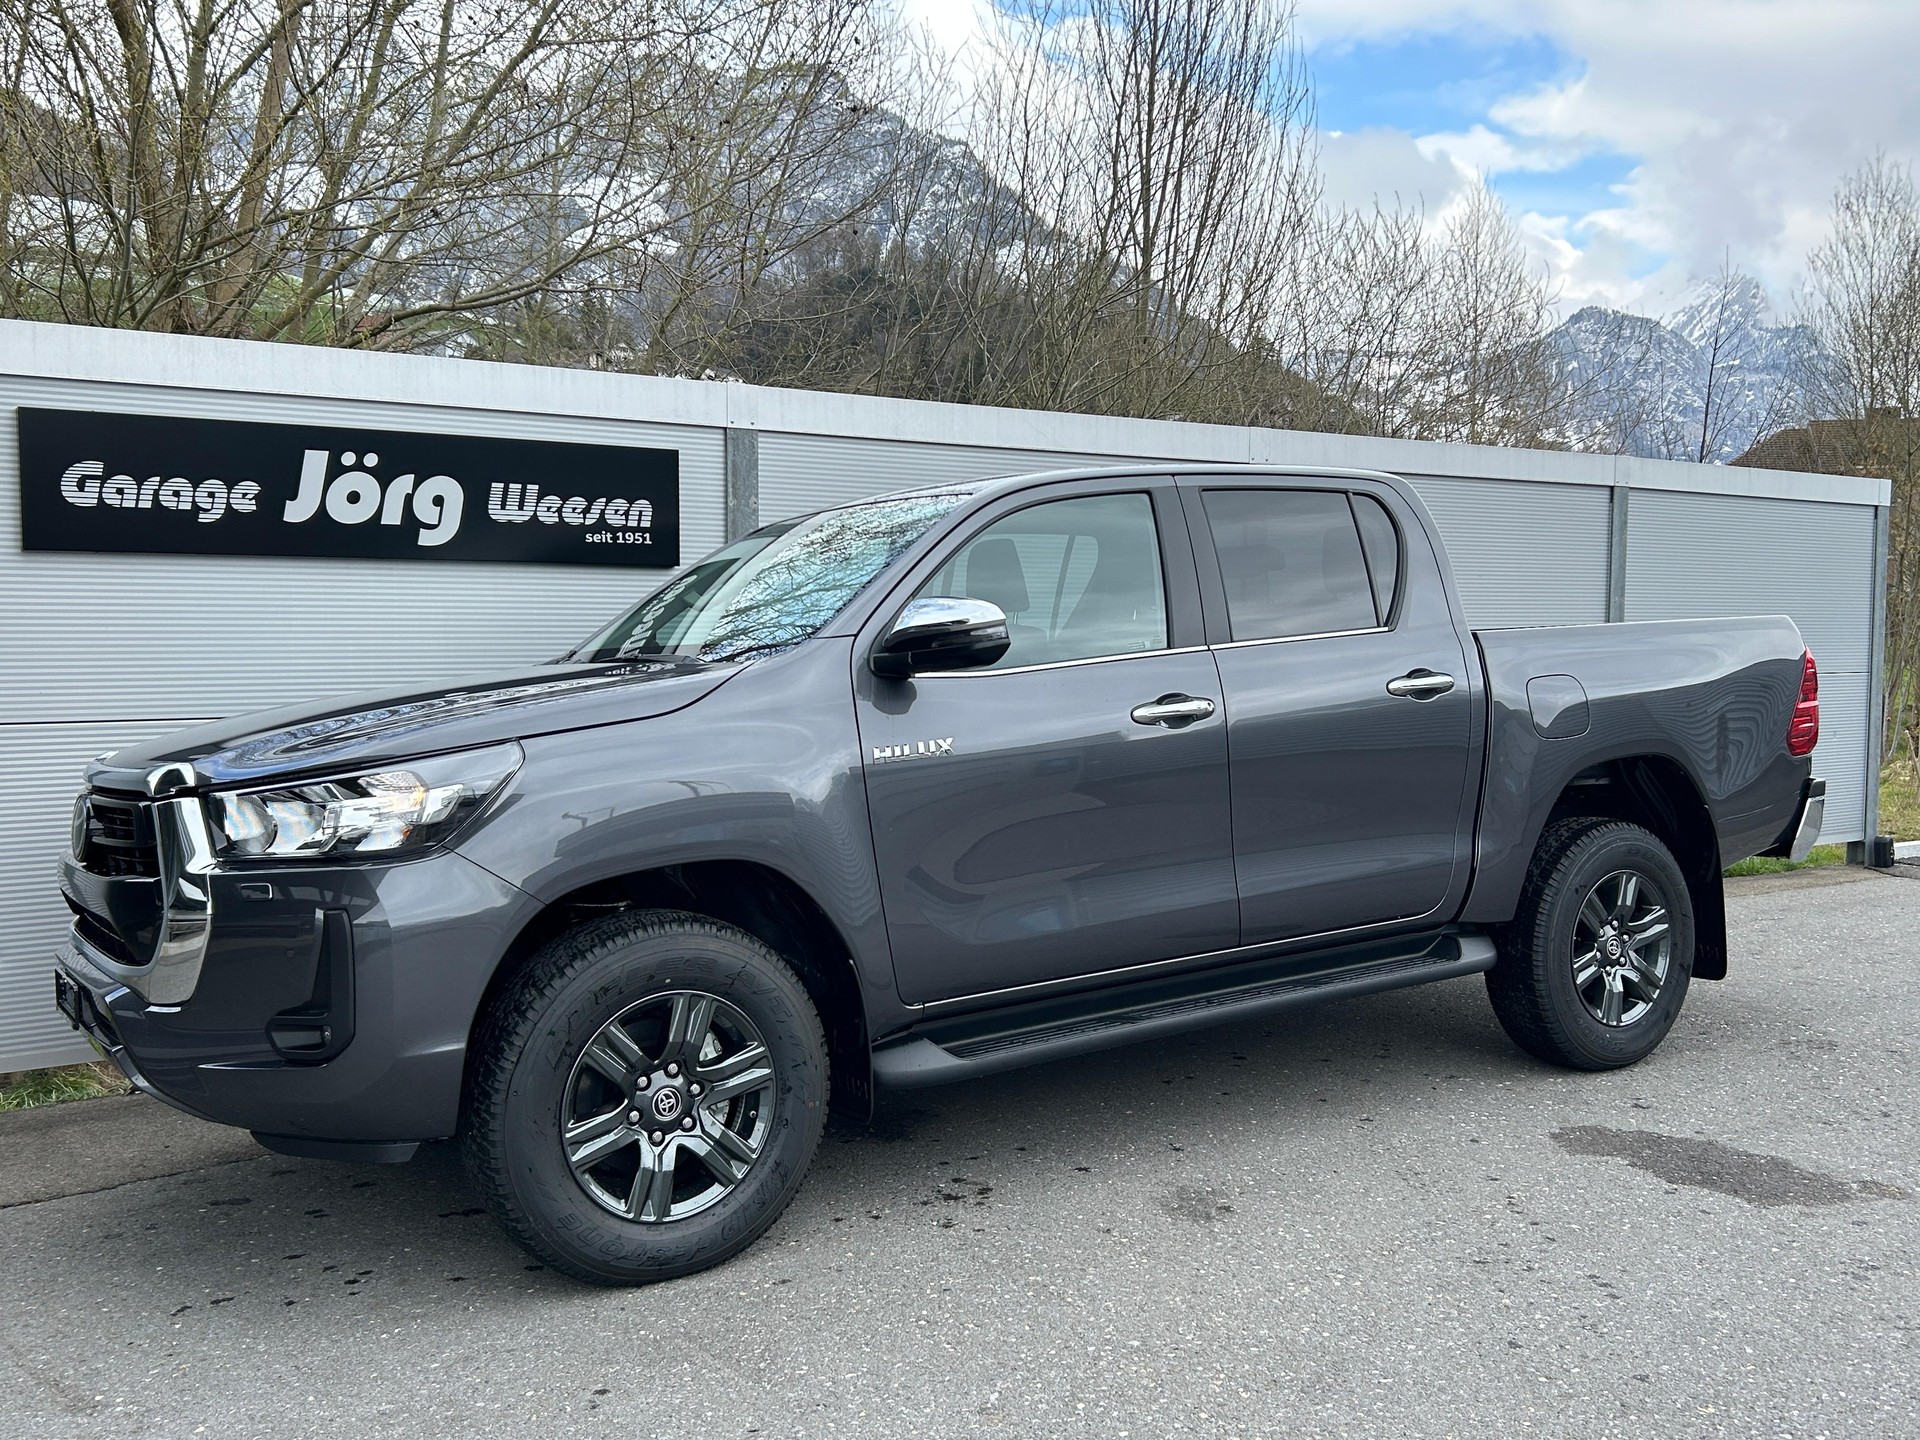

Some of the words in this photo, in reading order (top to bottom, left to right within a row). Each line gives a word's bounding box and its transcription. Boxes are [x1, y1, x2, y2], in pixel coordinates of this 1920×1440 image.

[60, 460, 262, 523] Garage
[283, 449, 465, 547] Jörg
[488, 482, 653, 528] Weesen
[585, 530, 613, 544] seit
[616, 530, 652, 545] 1951
[873, 737, 954, 764] HILUX
